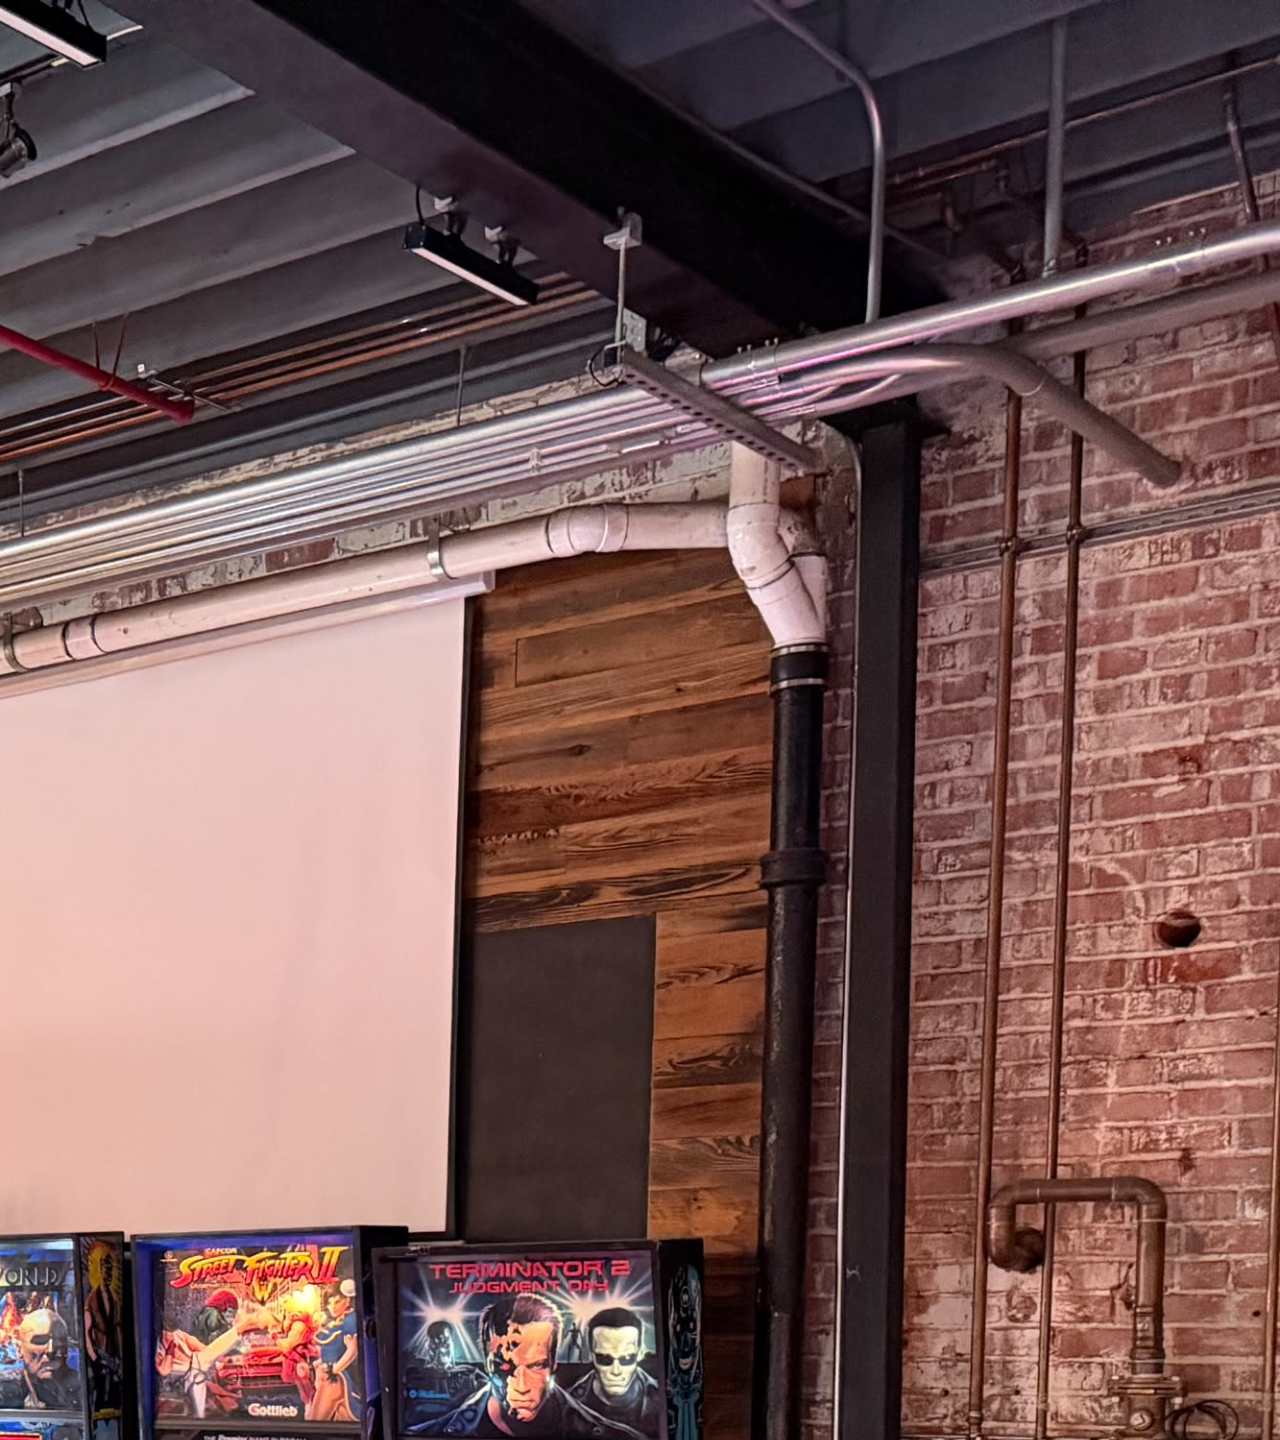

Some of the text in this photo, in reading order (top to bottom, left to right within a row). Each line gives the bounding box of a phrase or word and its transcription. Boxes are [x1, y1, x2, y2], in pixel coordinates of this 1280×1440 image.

[170, 1246, 349, 1288] STREET FIGHTER II
[429, 1260, 631, 1280] TERMINATOR 2
[449, 1279, 609, 1294] JUDGMENT DAY
[248, 1403, 298, 1417] Gottlieb
